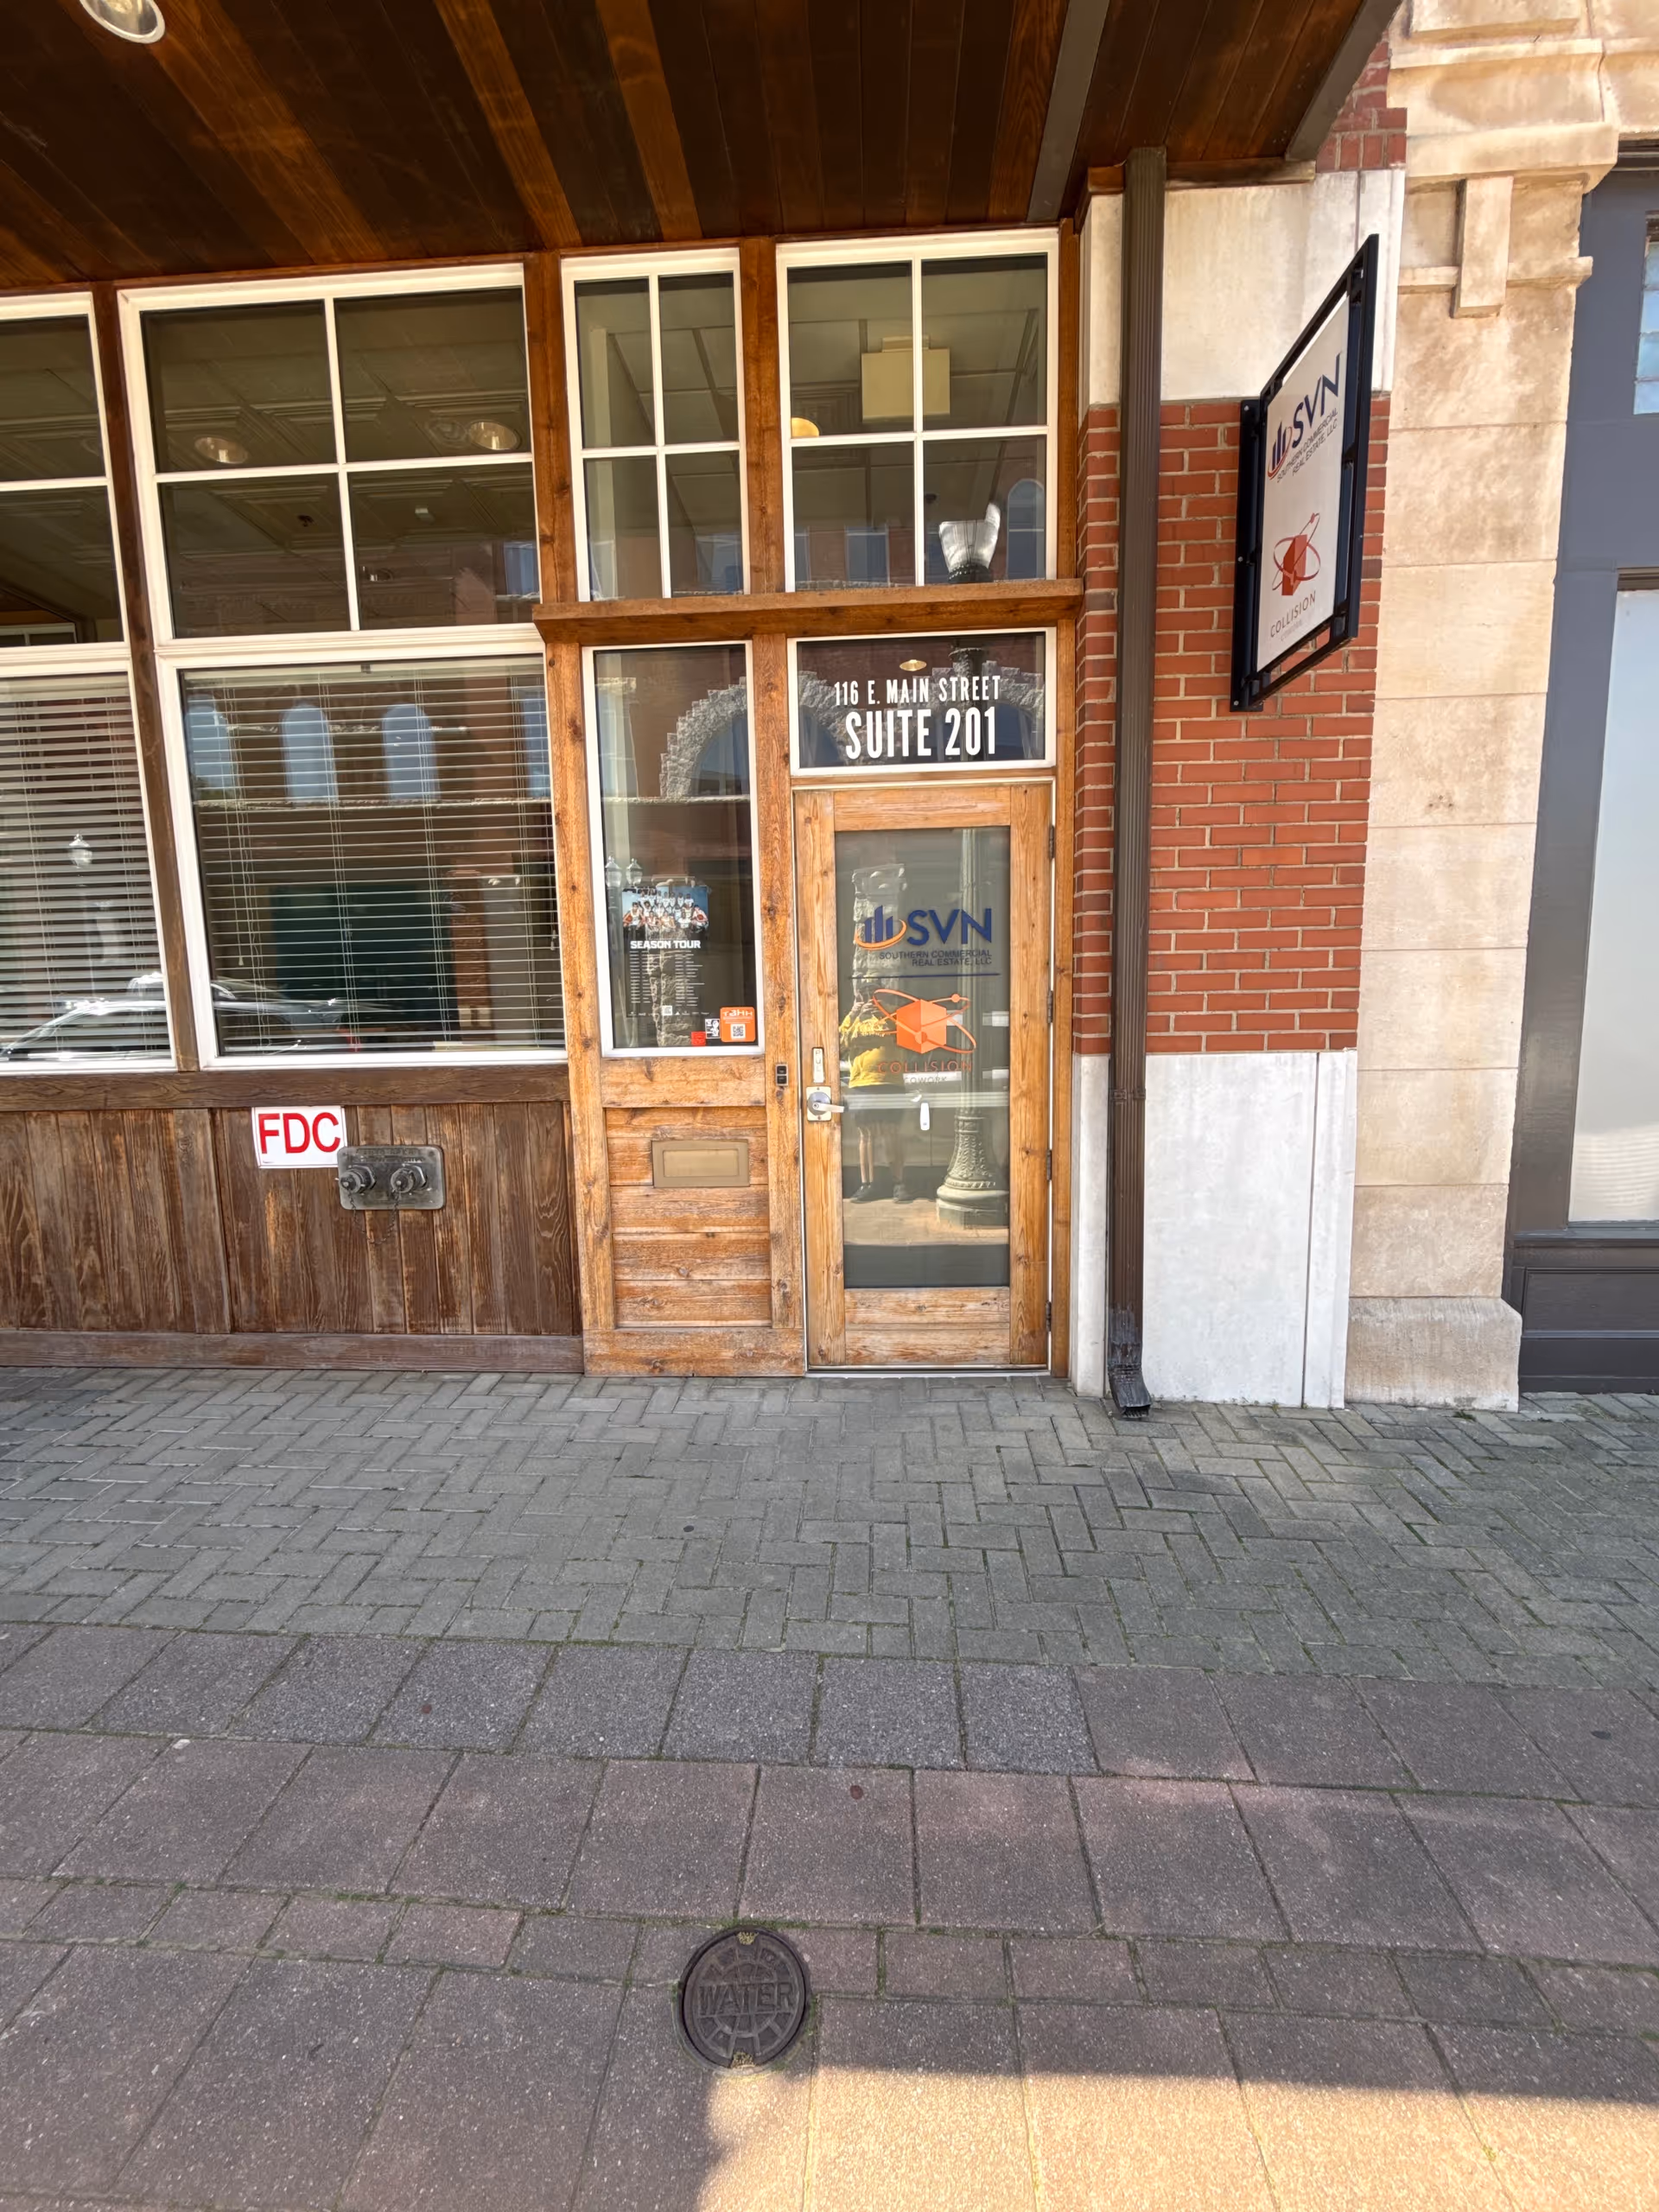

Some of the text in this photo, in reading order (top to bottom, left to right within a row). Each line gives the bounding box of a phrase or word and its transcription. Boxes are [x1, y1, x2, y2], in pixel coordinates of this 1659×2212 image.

[1292, 353, 1340, 449] SVN
[1276, 408, 1338, 483] SOUTHERN COMMERCIAL
[1292, 458, 1306, 476] REAL
[1326, 418, 1338, 437] LLC
[1270, 589, 1316, 638] COLLISION
[834, 675, 1001, 706] 116 E. MAIN STREET
[845, 706, 995, 760] SUITE 201
[630, 939, 701, 950] SEASON TOUR
[906, 908, 992, 946] SVN
[879, 949, 992, 960] SOUTHERN COMMERCIAL
[912, 958, 934, 967] REAL
[975, 957, 992, 965] LLC
[877, 1060, 972, 1074] COLLISION
[904, 1076, 947, 1084] COWORK
[258, 1112, 340, 1154] FDC
[697, 1981, 793, 2017] WATER
